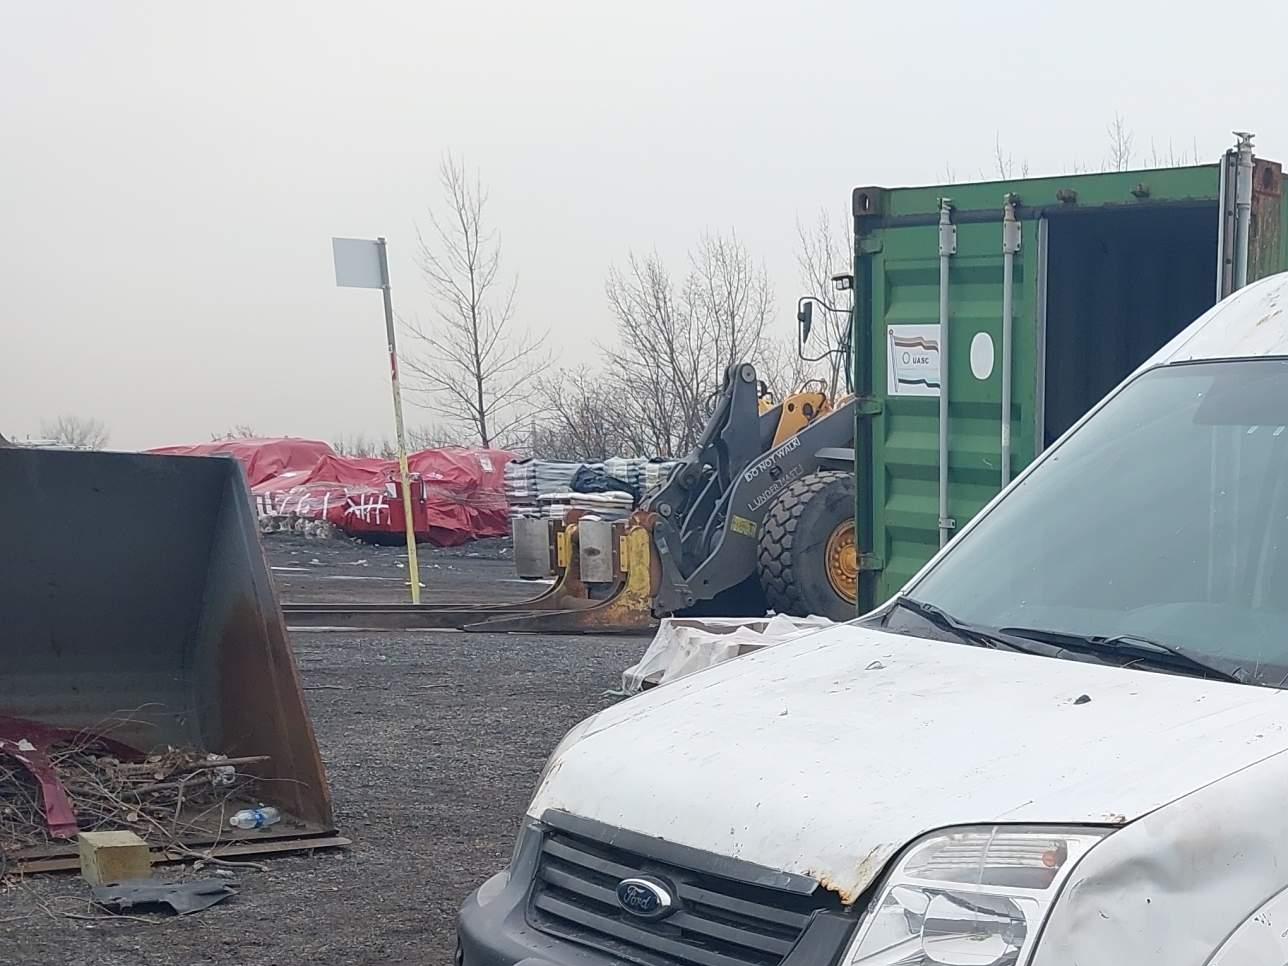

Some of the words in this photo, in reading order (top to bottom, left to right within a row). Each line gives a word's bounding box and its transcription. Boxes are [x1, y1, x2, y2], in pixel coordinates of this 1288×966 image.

[912, 356, 929, 365] UASC
[745, 469, 759, 481] DO
[760, 454, 776, 472] NOT
[776, 437, 799, 459] WALK
[624, 886, 652, 909] Ford
